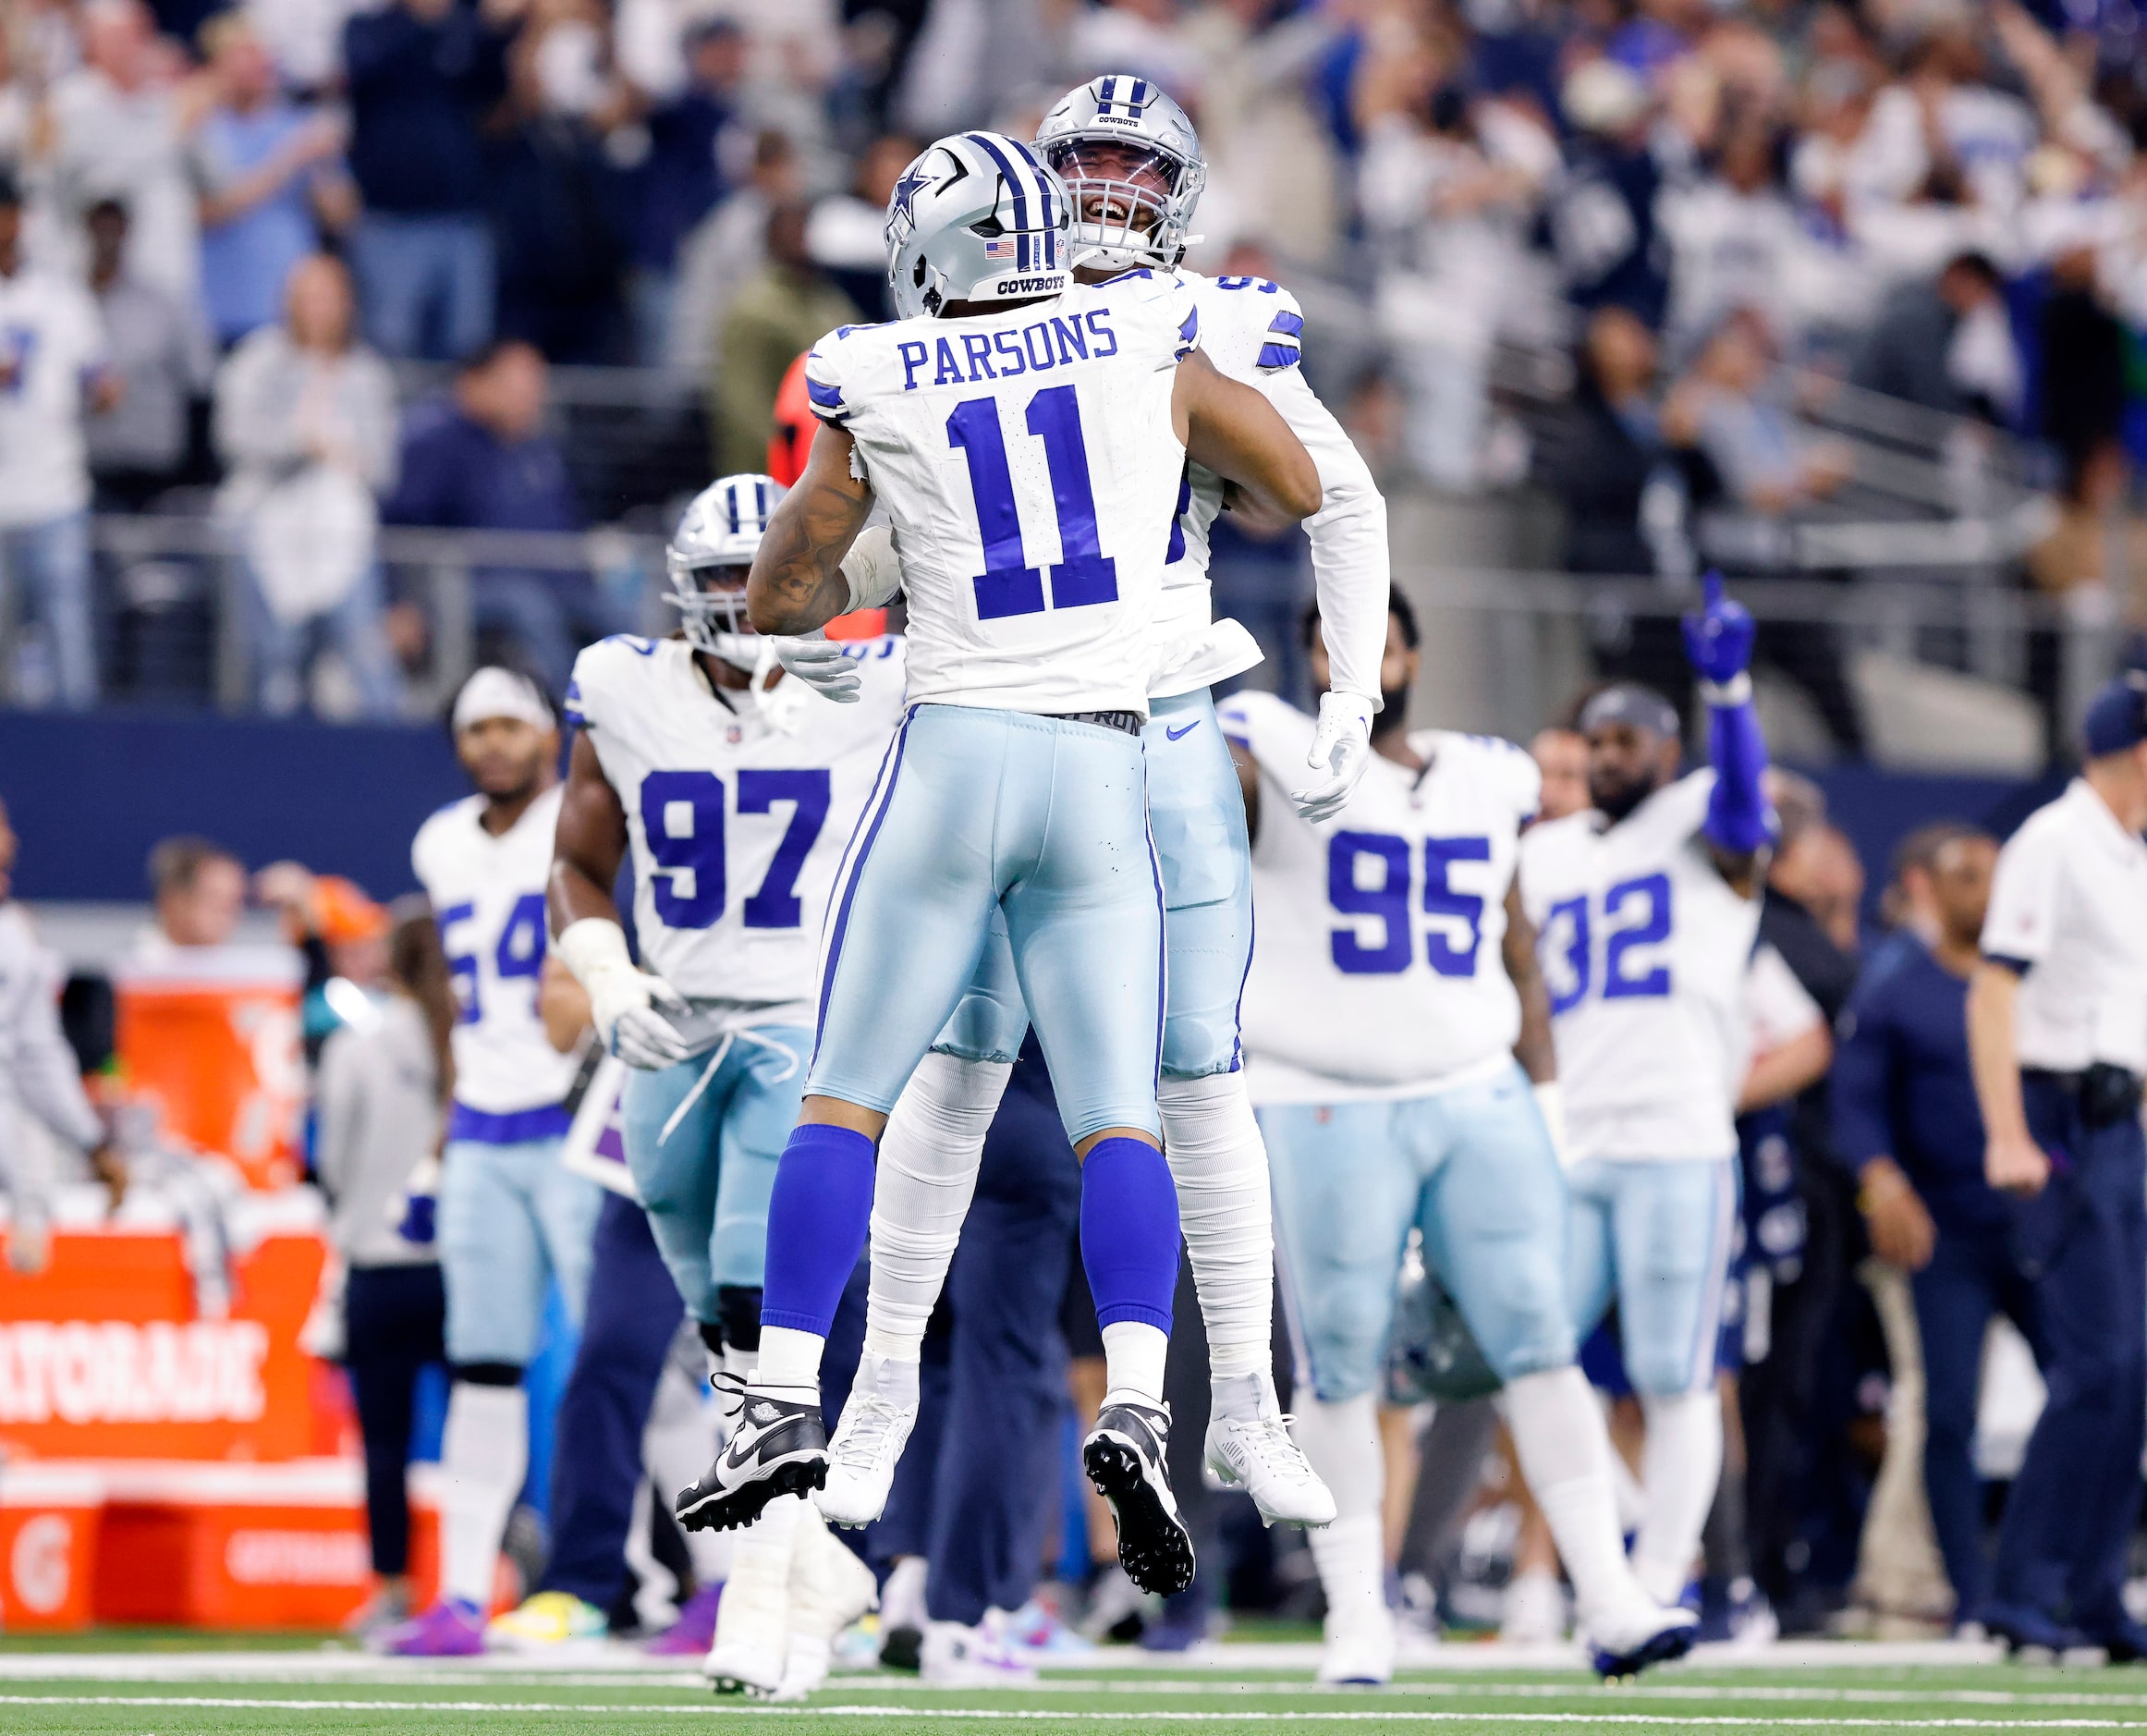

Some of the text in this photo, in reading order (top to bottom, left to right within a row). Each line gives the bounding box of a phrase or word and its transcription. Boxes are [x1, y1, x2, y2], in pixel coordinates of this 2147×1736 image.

[1098, 116, 1139, 128] COWBOYS
[997, 275, 1065, 295] COWBOYS
[897, 308, 1118, 391] PARSONS
[945, 384, 1119, 620] 11
[640, 769, 831, 930] 97
[1328, 829, 1490, 977] 95
